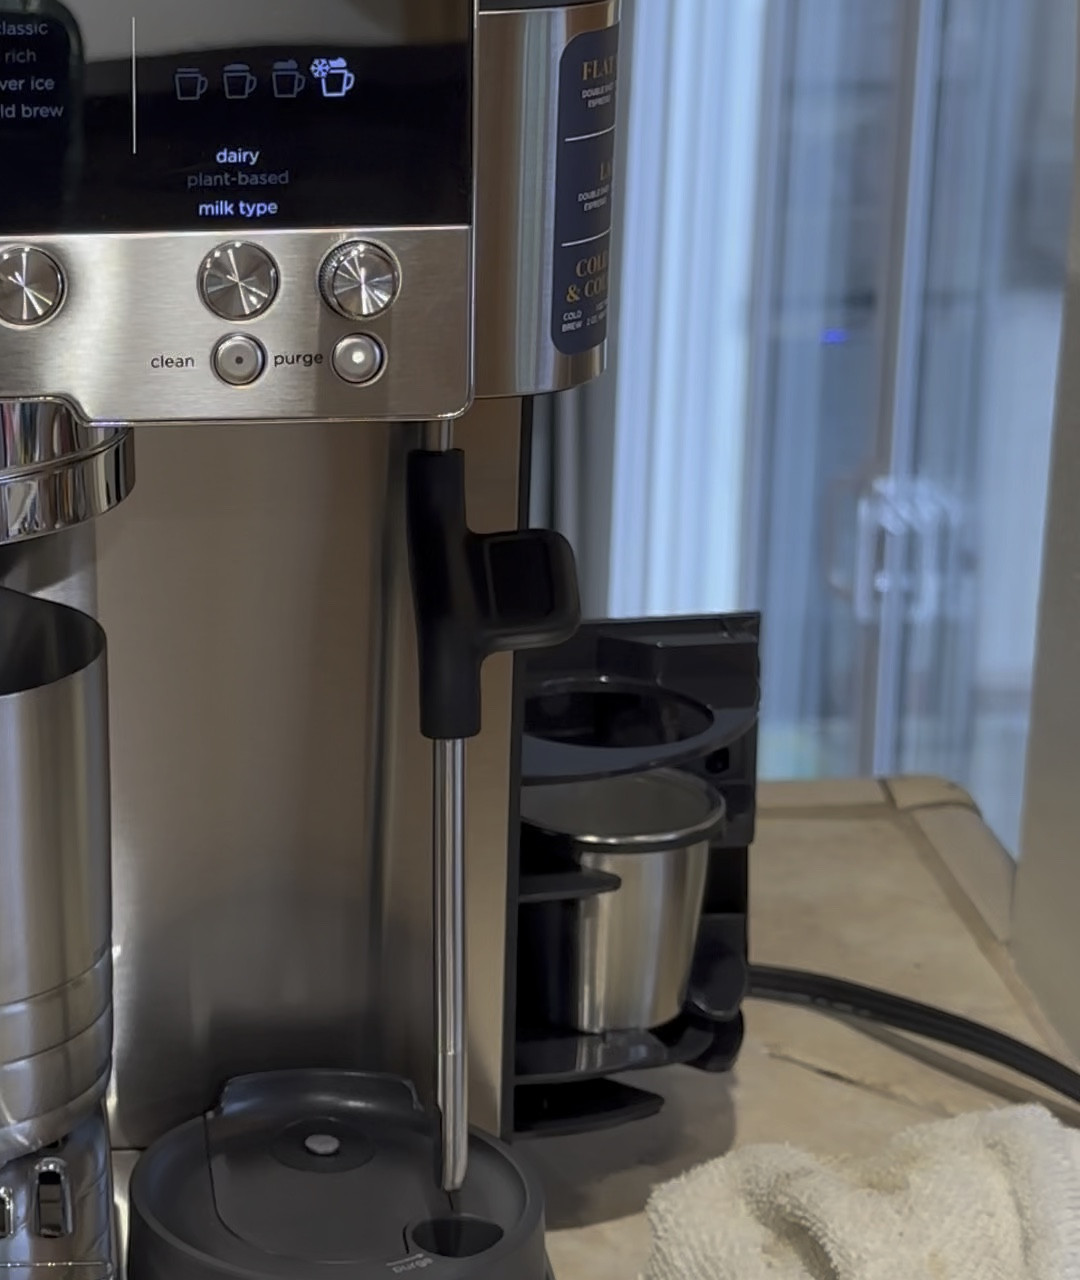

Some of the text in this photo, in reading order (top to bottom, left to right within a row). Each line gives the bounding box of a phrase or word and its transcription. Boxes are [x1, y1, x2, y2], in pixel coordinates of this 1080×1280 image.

[5, 48, 37, 64] rich
[31, 76, 55, 91] ice
[21, 103, 64, 119] brew
[215, 147, 260, 166] dairy
[187, 170, 289, 188] plant-based
[199, 200, 278, 218] milk type
[150, 353, 195, 369] clean
[273, 351, 324, 368] purge
